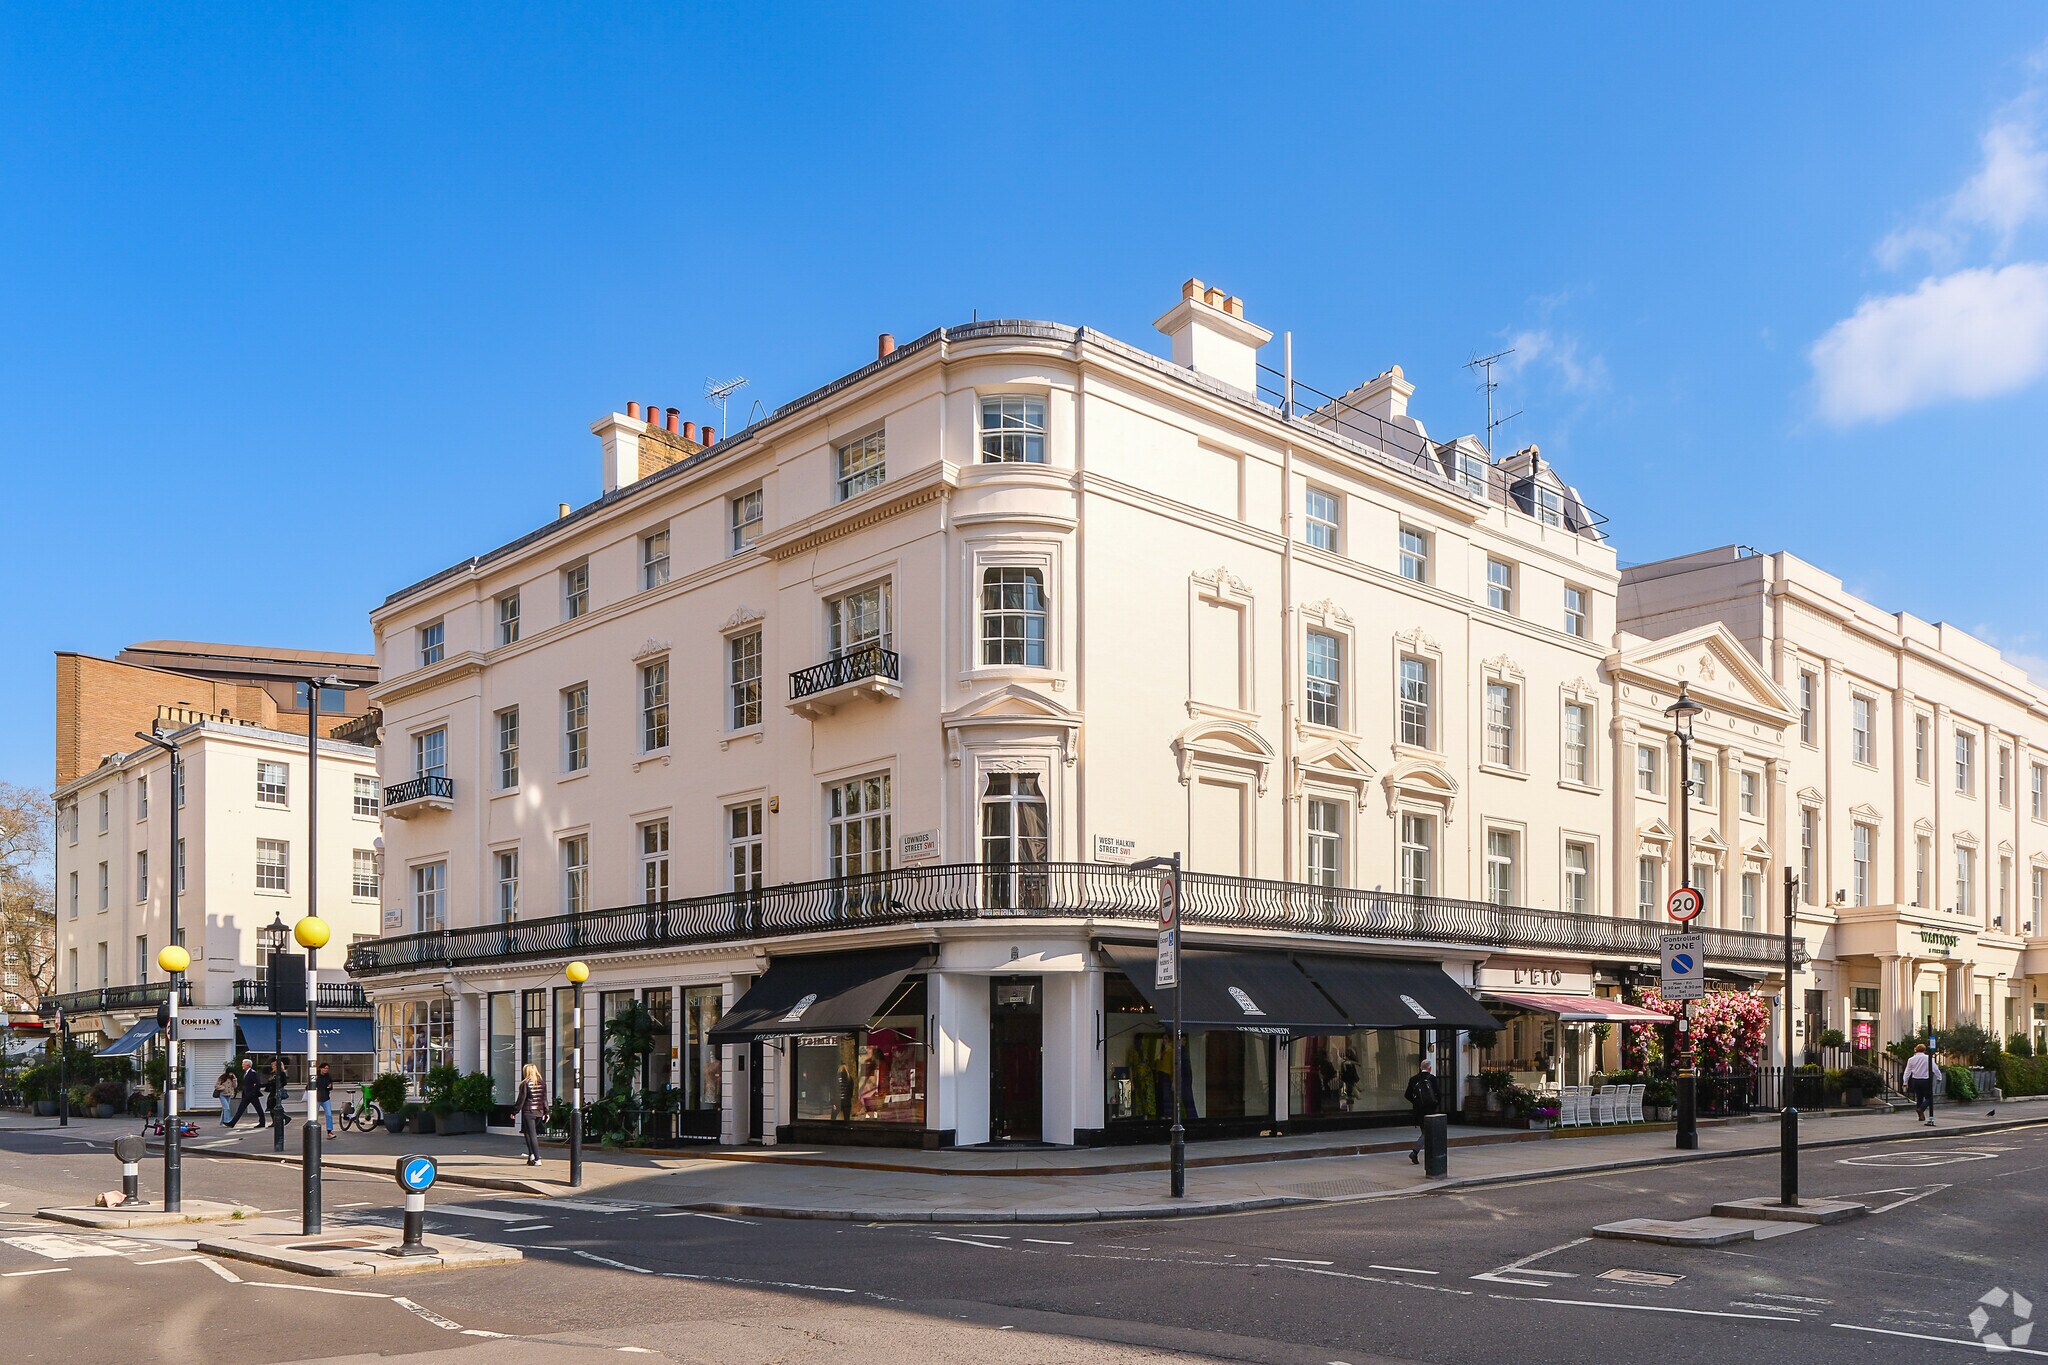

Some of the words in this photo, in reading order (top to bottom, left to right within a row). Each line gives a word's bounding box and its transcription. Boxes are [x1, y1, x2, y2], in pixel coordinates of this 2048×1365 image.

[904, 834, 930, 844] LOWNDES
[1099, 837, 1114, 845] WEST
[1115, 839, 1136, 848] HALKIN
[904, 843, 924, 853] STREET
[924, 841, 935, 850] SW1
[1098, 844, 1119, 854] STREET
[1119, 847, 1131, 855] SW1
[1672, 897, 1695, 912] 20
[1663, 935, 1700, 943] Controlled
[180, 1018, 222, 1026] CORTHAY
